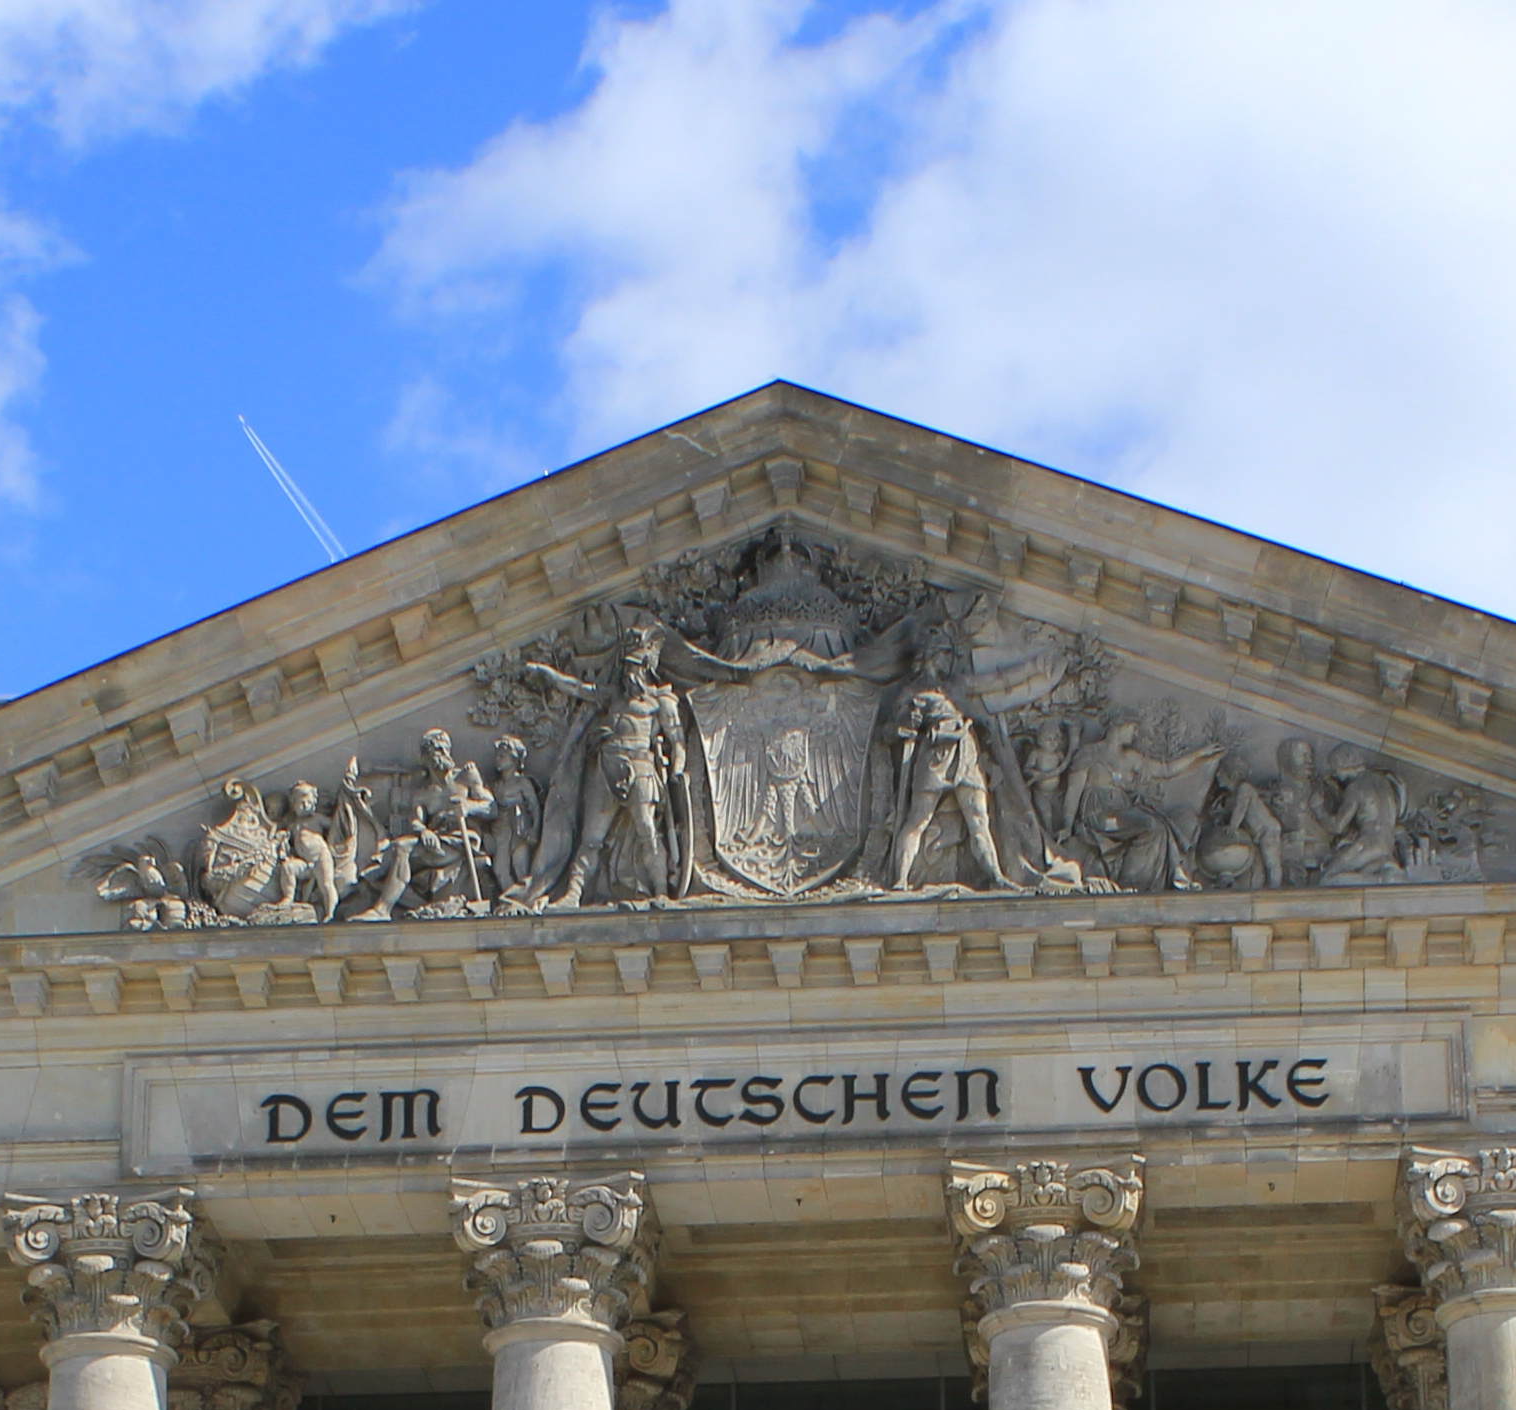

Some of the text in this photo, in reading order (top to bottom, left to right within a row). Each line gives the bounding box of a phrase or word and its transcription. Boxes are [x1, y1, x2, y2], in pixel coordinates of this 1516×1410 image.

[260, 1059, 1331, 1143] DEM DEUTSCHEN VOLKE
